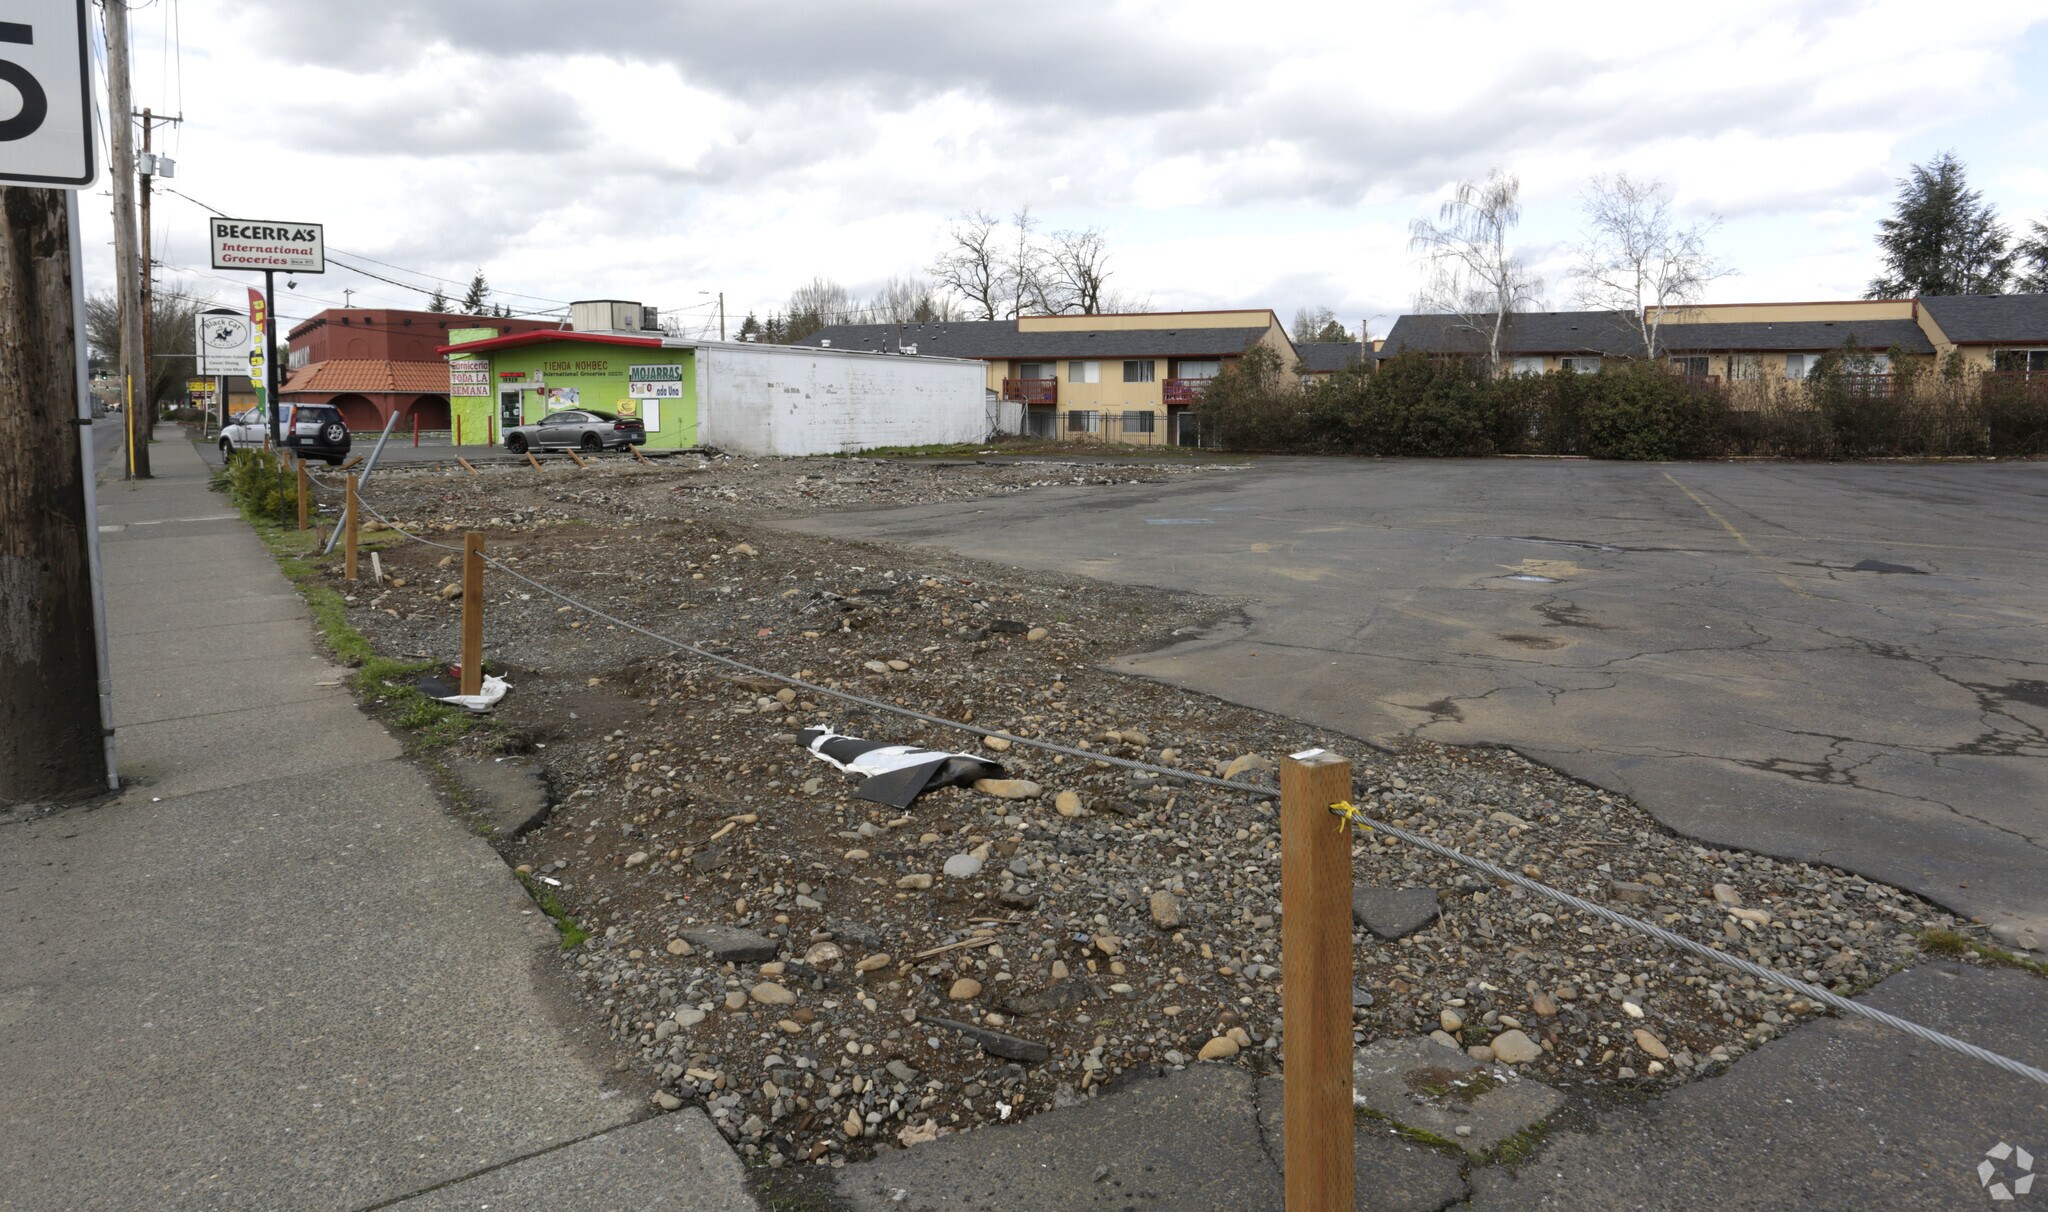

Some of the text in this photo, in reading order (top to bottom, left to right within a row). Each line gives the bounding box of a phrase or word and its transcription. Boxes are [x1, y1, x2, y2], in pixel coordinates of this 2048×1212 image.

[217, 224, 316, 242] BECERRA'S
[222, 243, 313, 256] International
[222, 254, 288, 265] Groceries
[204, 319, 241, 331] Black Cat
[544, 361, 608, 370] TIENDA NOHBEC
[452, 374, 488, 382] TODA LA
[631, 366, 680, 381] MOJARRAS
[452, 386, 488, 395] SEMANA
[655, 384, 668, 397] ada
[668, 386, 680, 396] Una
